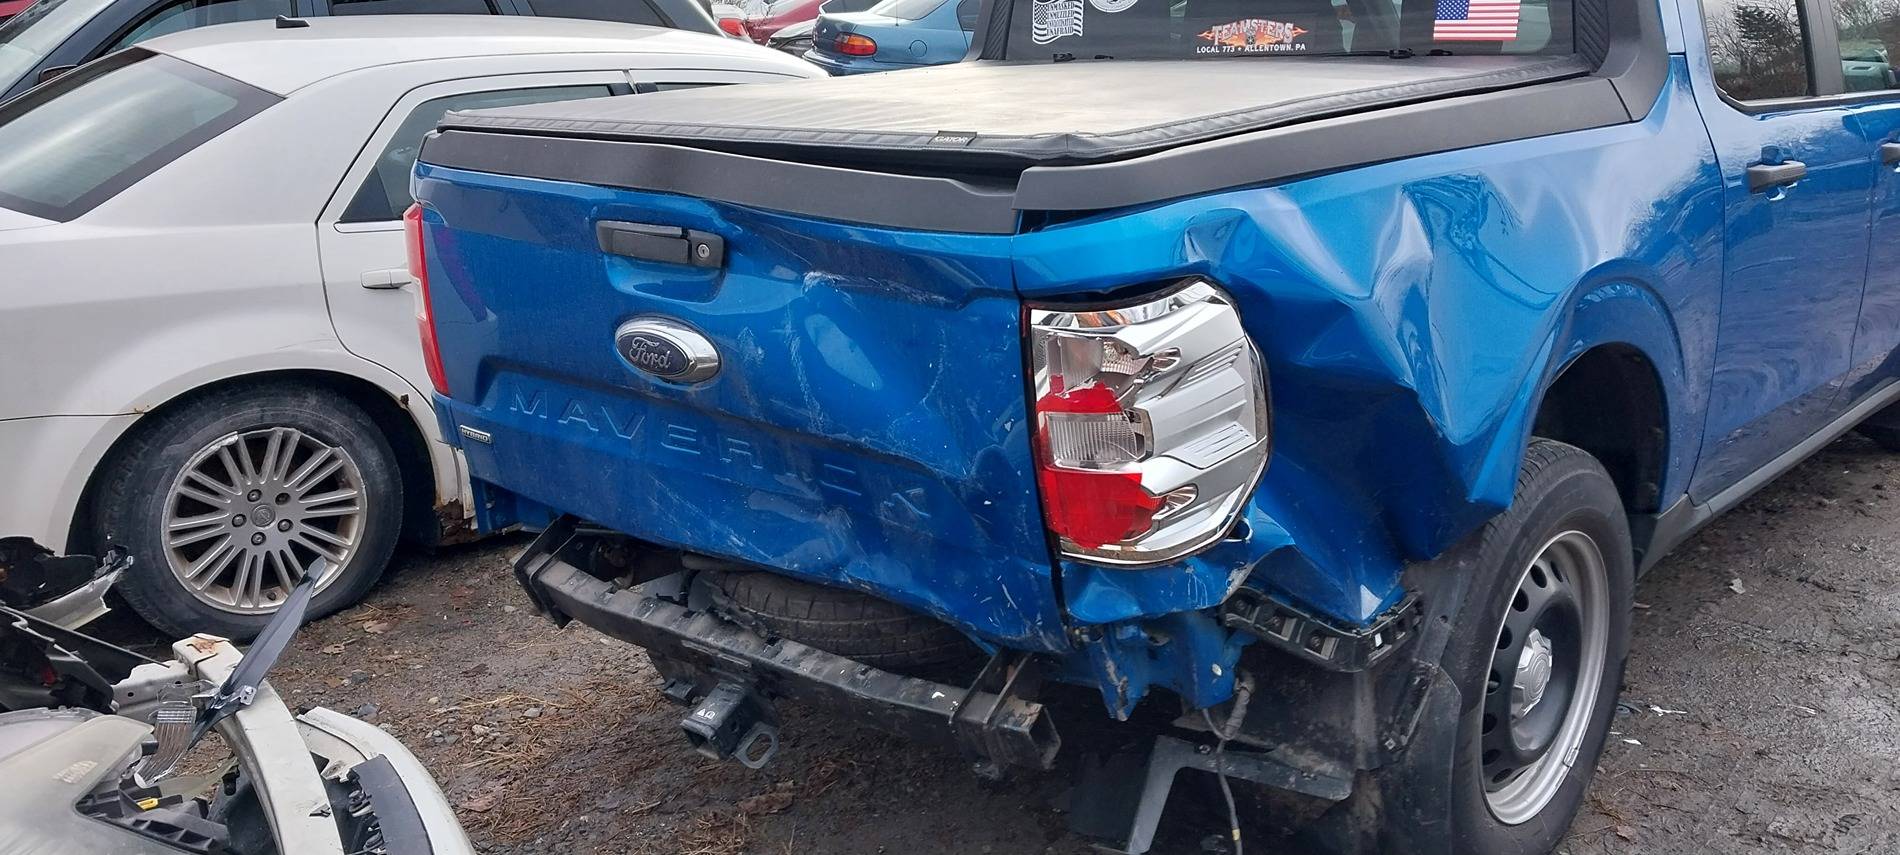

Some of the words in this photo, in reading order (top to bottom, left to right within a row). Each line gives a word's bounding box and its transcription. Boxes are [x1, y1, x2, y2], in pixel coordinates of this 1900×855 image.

[1046, 26, 1073, 35] UNAFRAID
[1212, 19, 1294, 45] TEAMSTERS
[1222, 45, 1235, 53] 773
[1295, 43, 1306, 51] PA
[629, 336, 671, 369] Ford
[461, 428, 488, 442] HYBRID
[510, 384, 931, 517] MAVERCK
